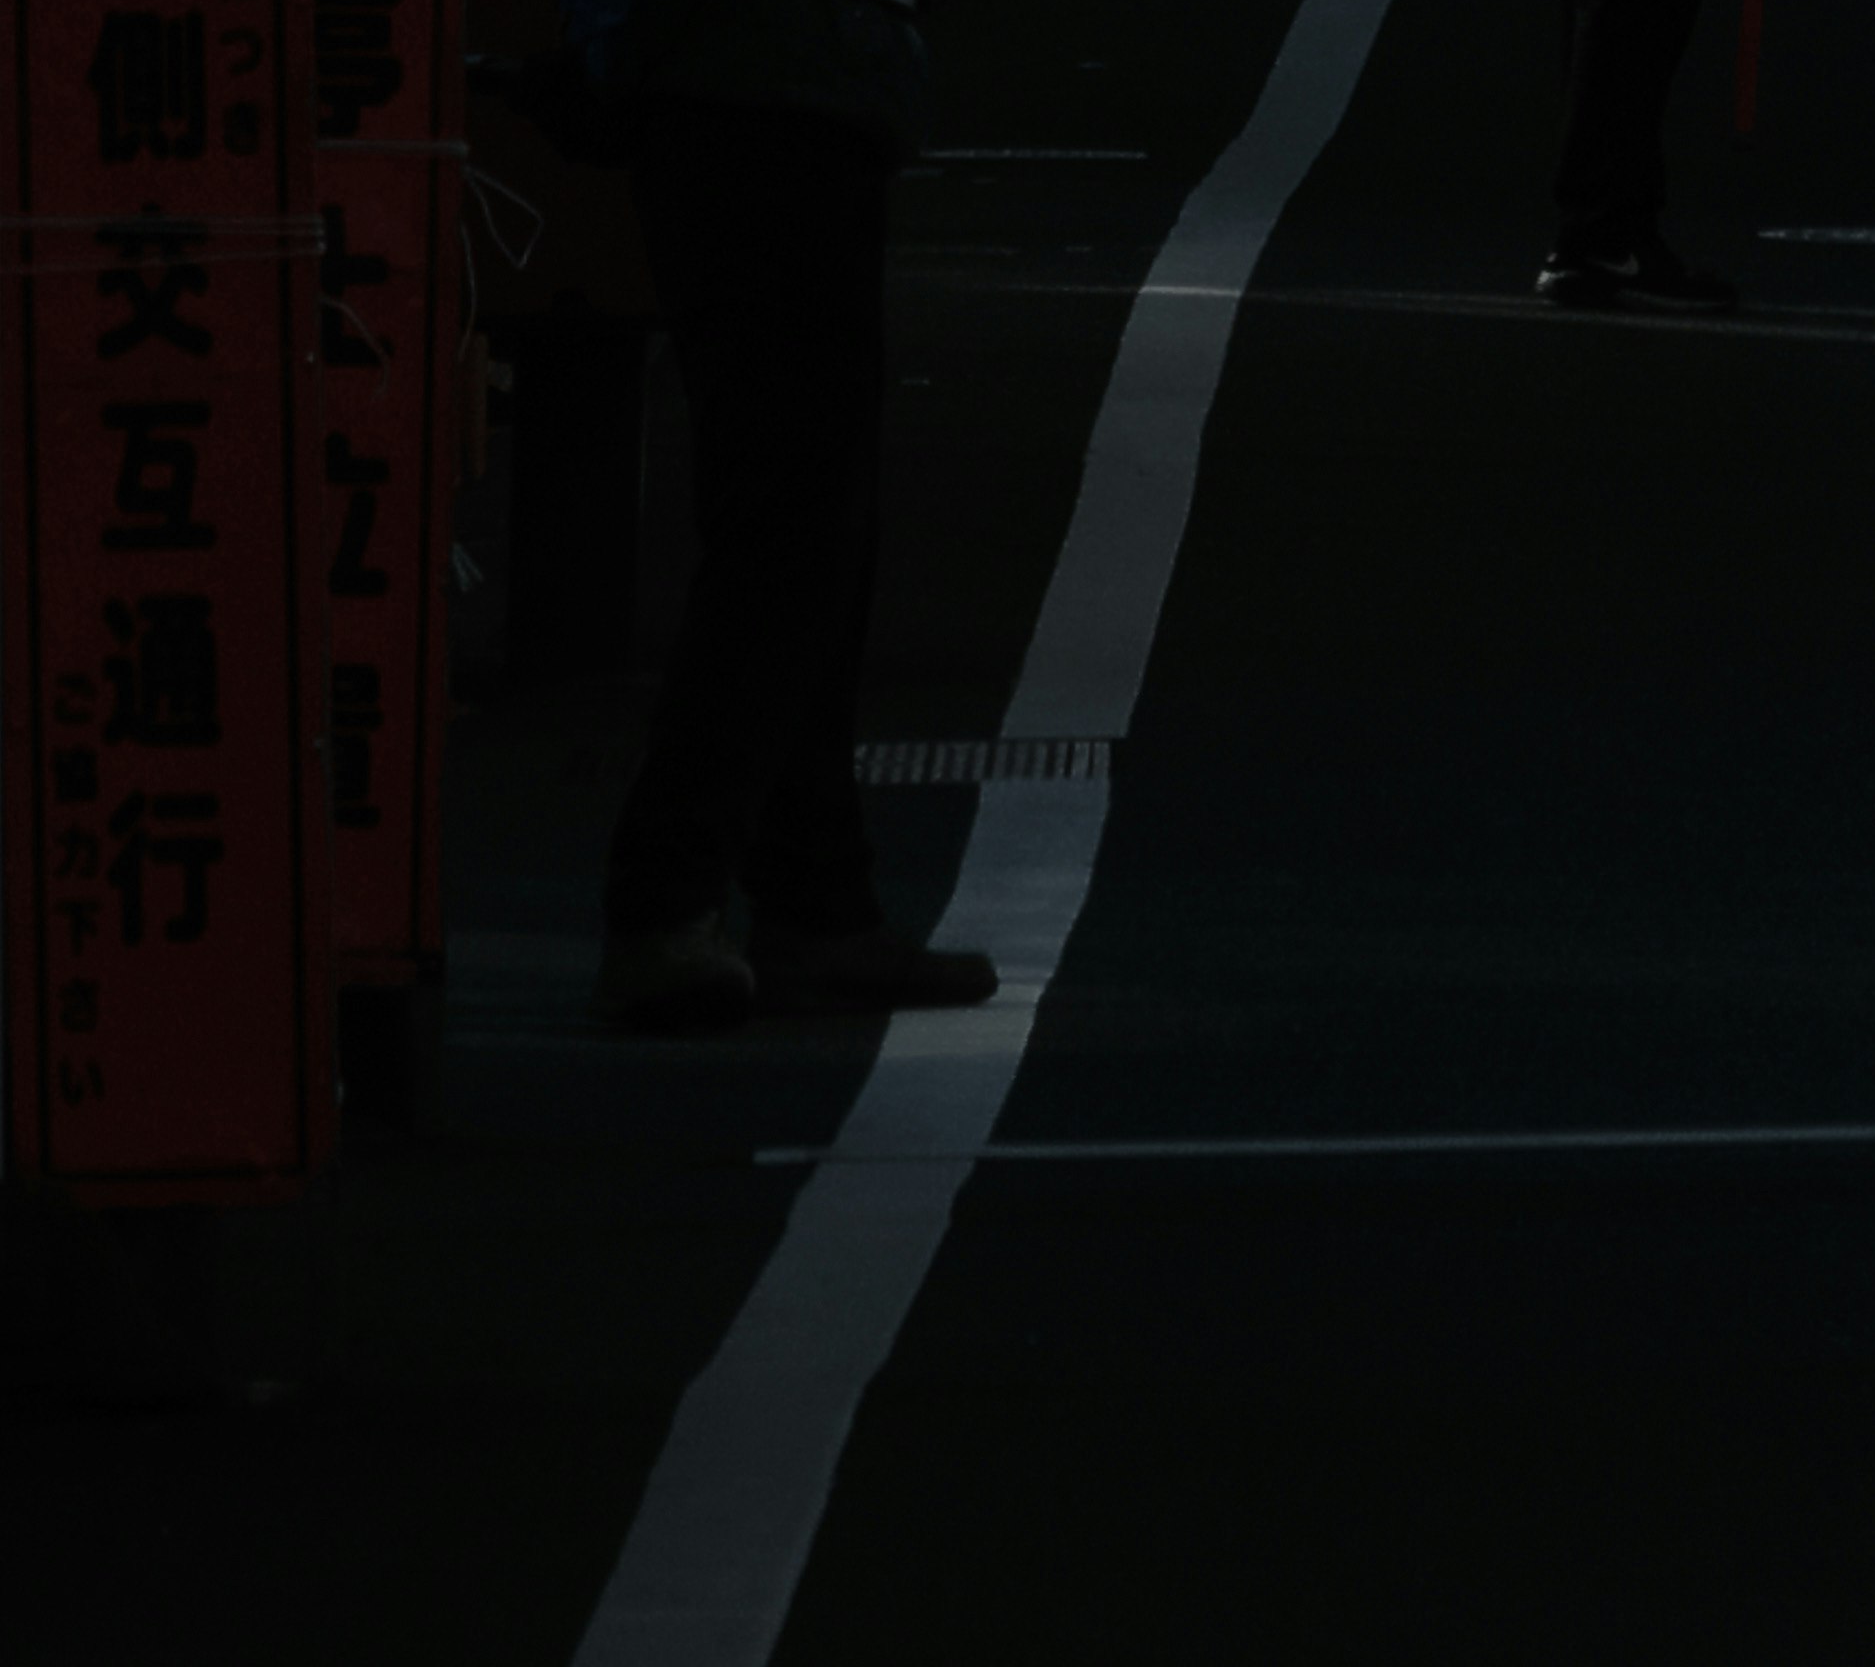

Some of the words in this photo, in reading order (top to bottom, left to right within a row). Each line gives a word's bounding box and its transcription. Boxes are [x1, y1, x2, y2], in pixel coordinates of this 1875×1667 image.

[52, 674, 105, 1107] ご協力下さい
